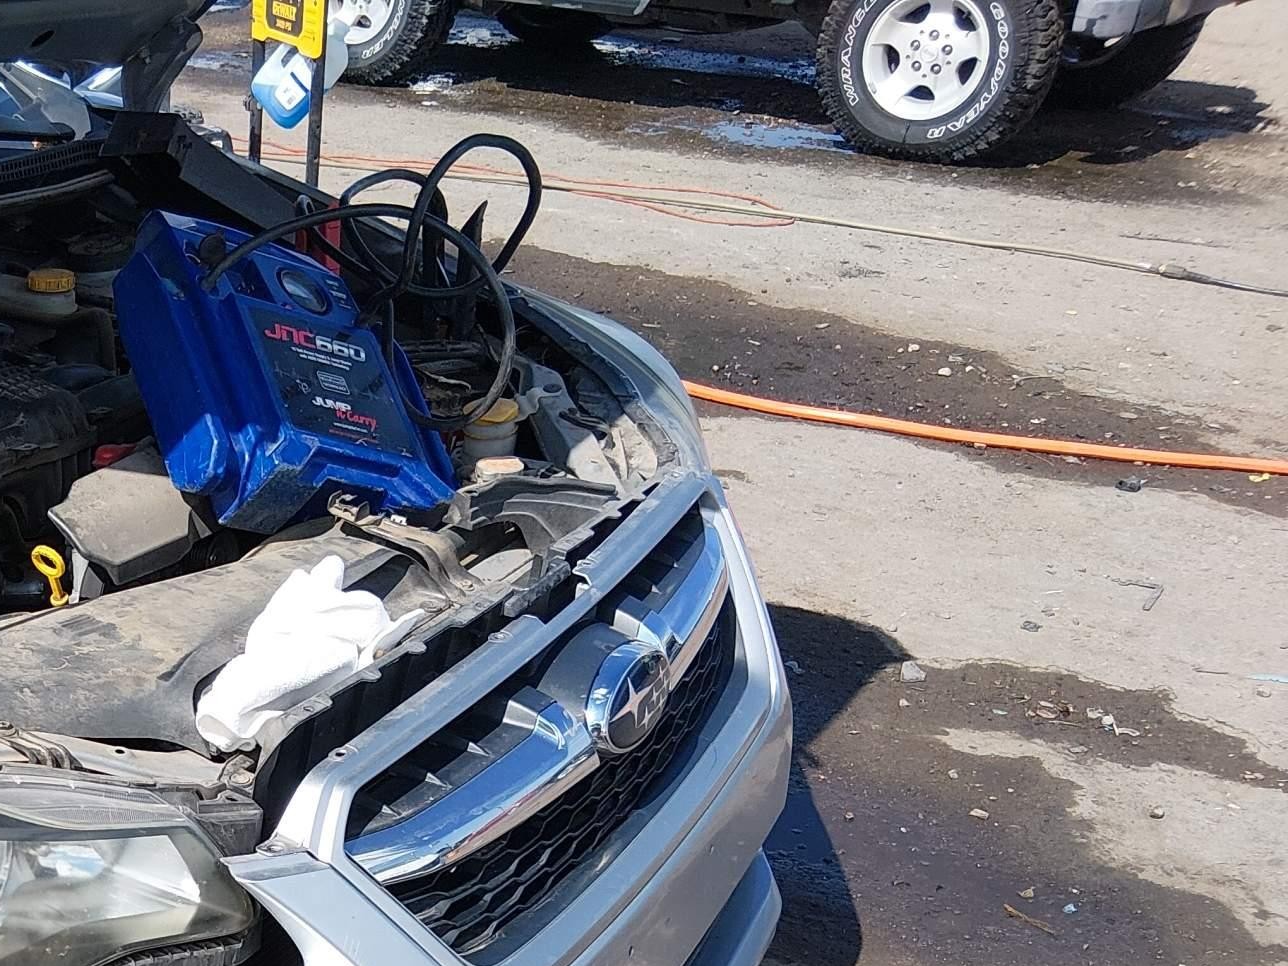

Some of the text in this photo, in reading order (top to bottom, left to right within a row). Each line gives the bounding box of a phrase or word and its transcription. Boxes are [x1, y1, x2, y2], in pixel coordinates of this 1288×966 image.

[927, 2, 1009, 139] GOODYEAR
[264, 323, 365, 362] JNC660
[312, 396, 352, 411] JUMP
